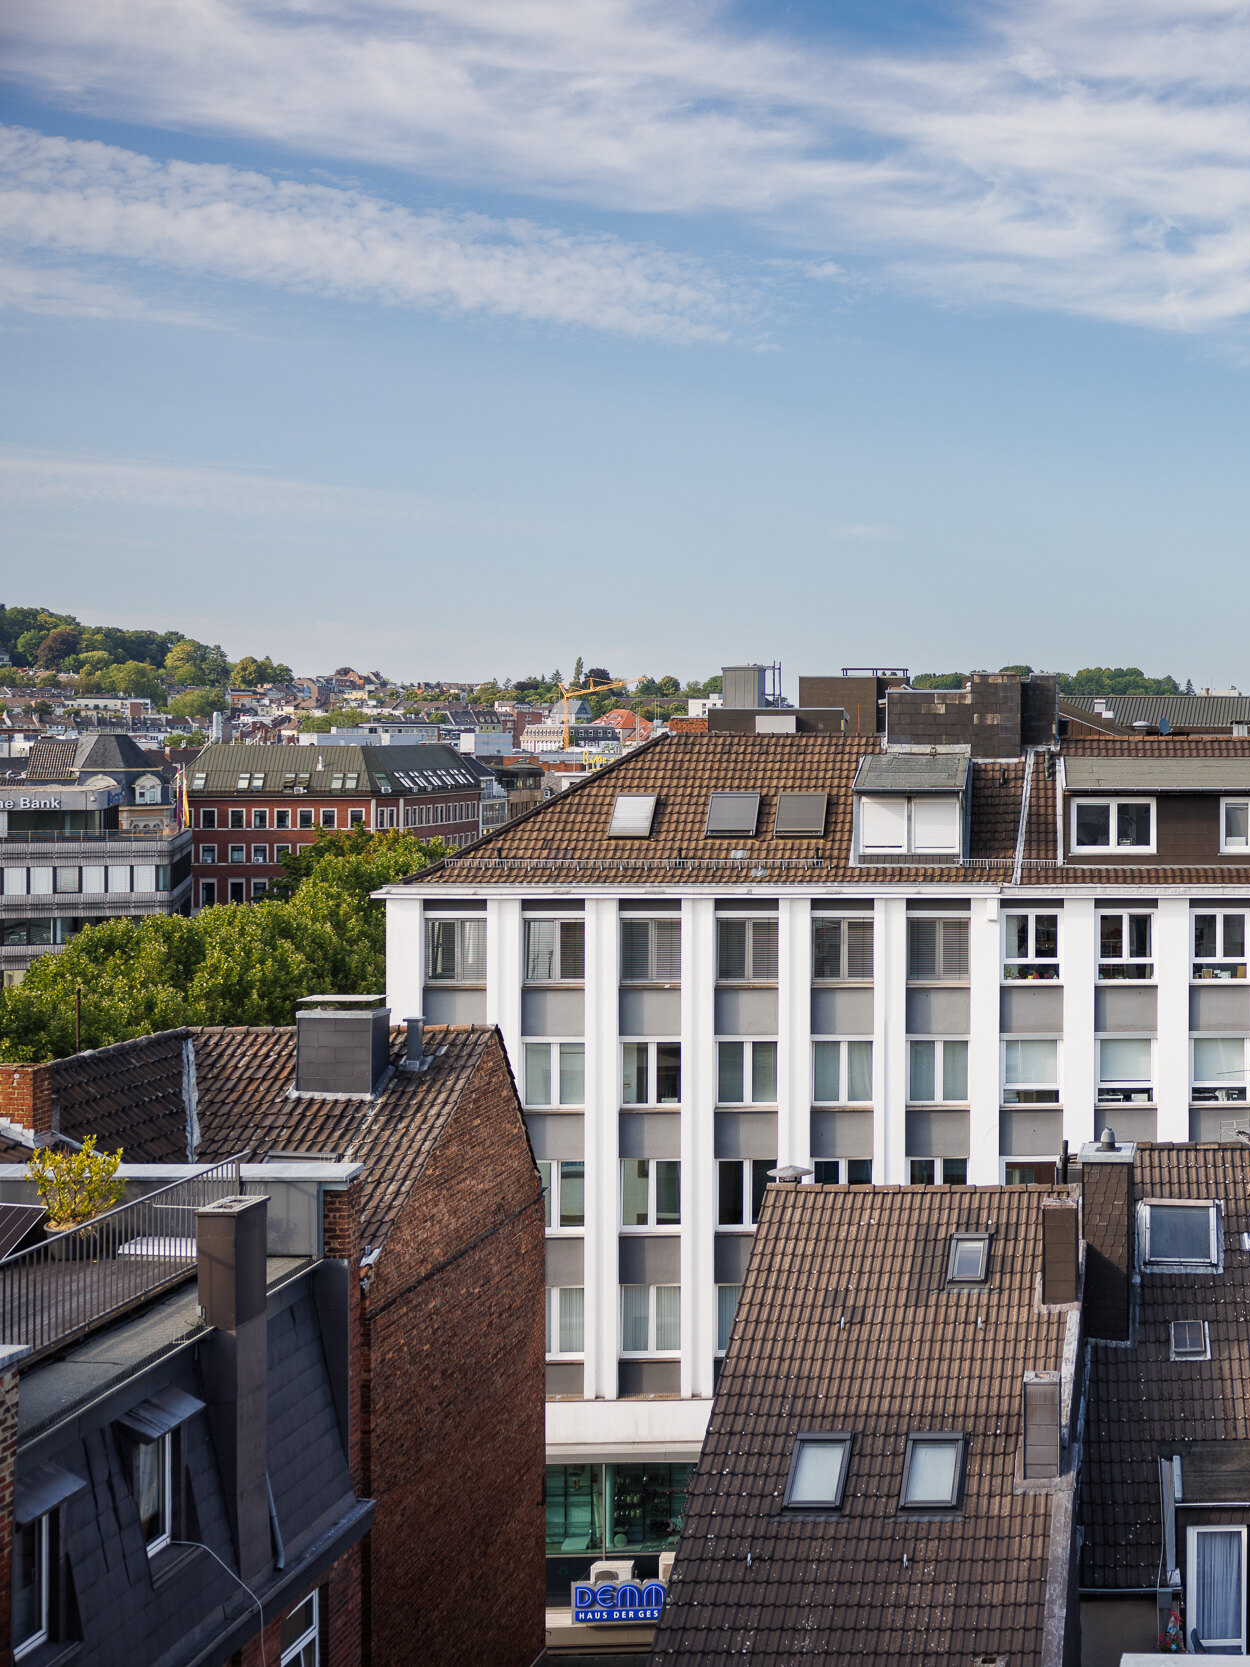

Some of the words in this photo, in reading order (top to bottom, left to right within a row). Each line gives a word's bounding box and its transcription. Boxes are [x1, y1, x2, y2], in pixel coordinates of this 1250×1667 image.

[20, 797, 60, 809] Bank
[579, 1611, 608, 1620] HAUS
[613, 1610, 635, 1619] DER
[638, 1610, 659, 1618] GES
